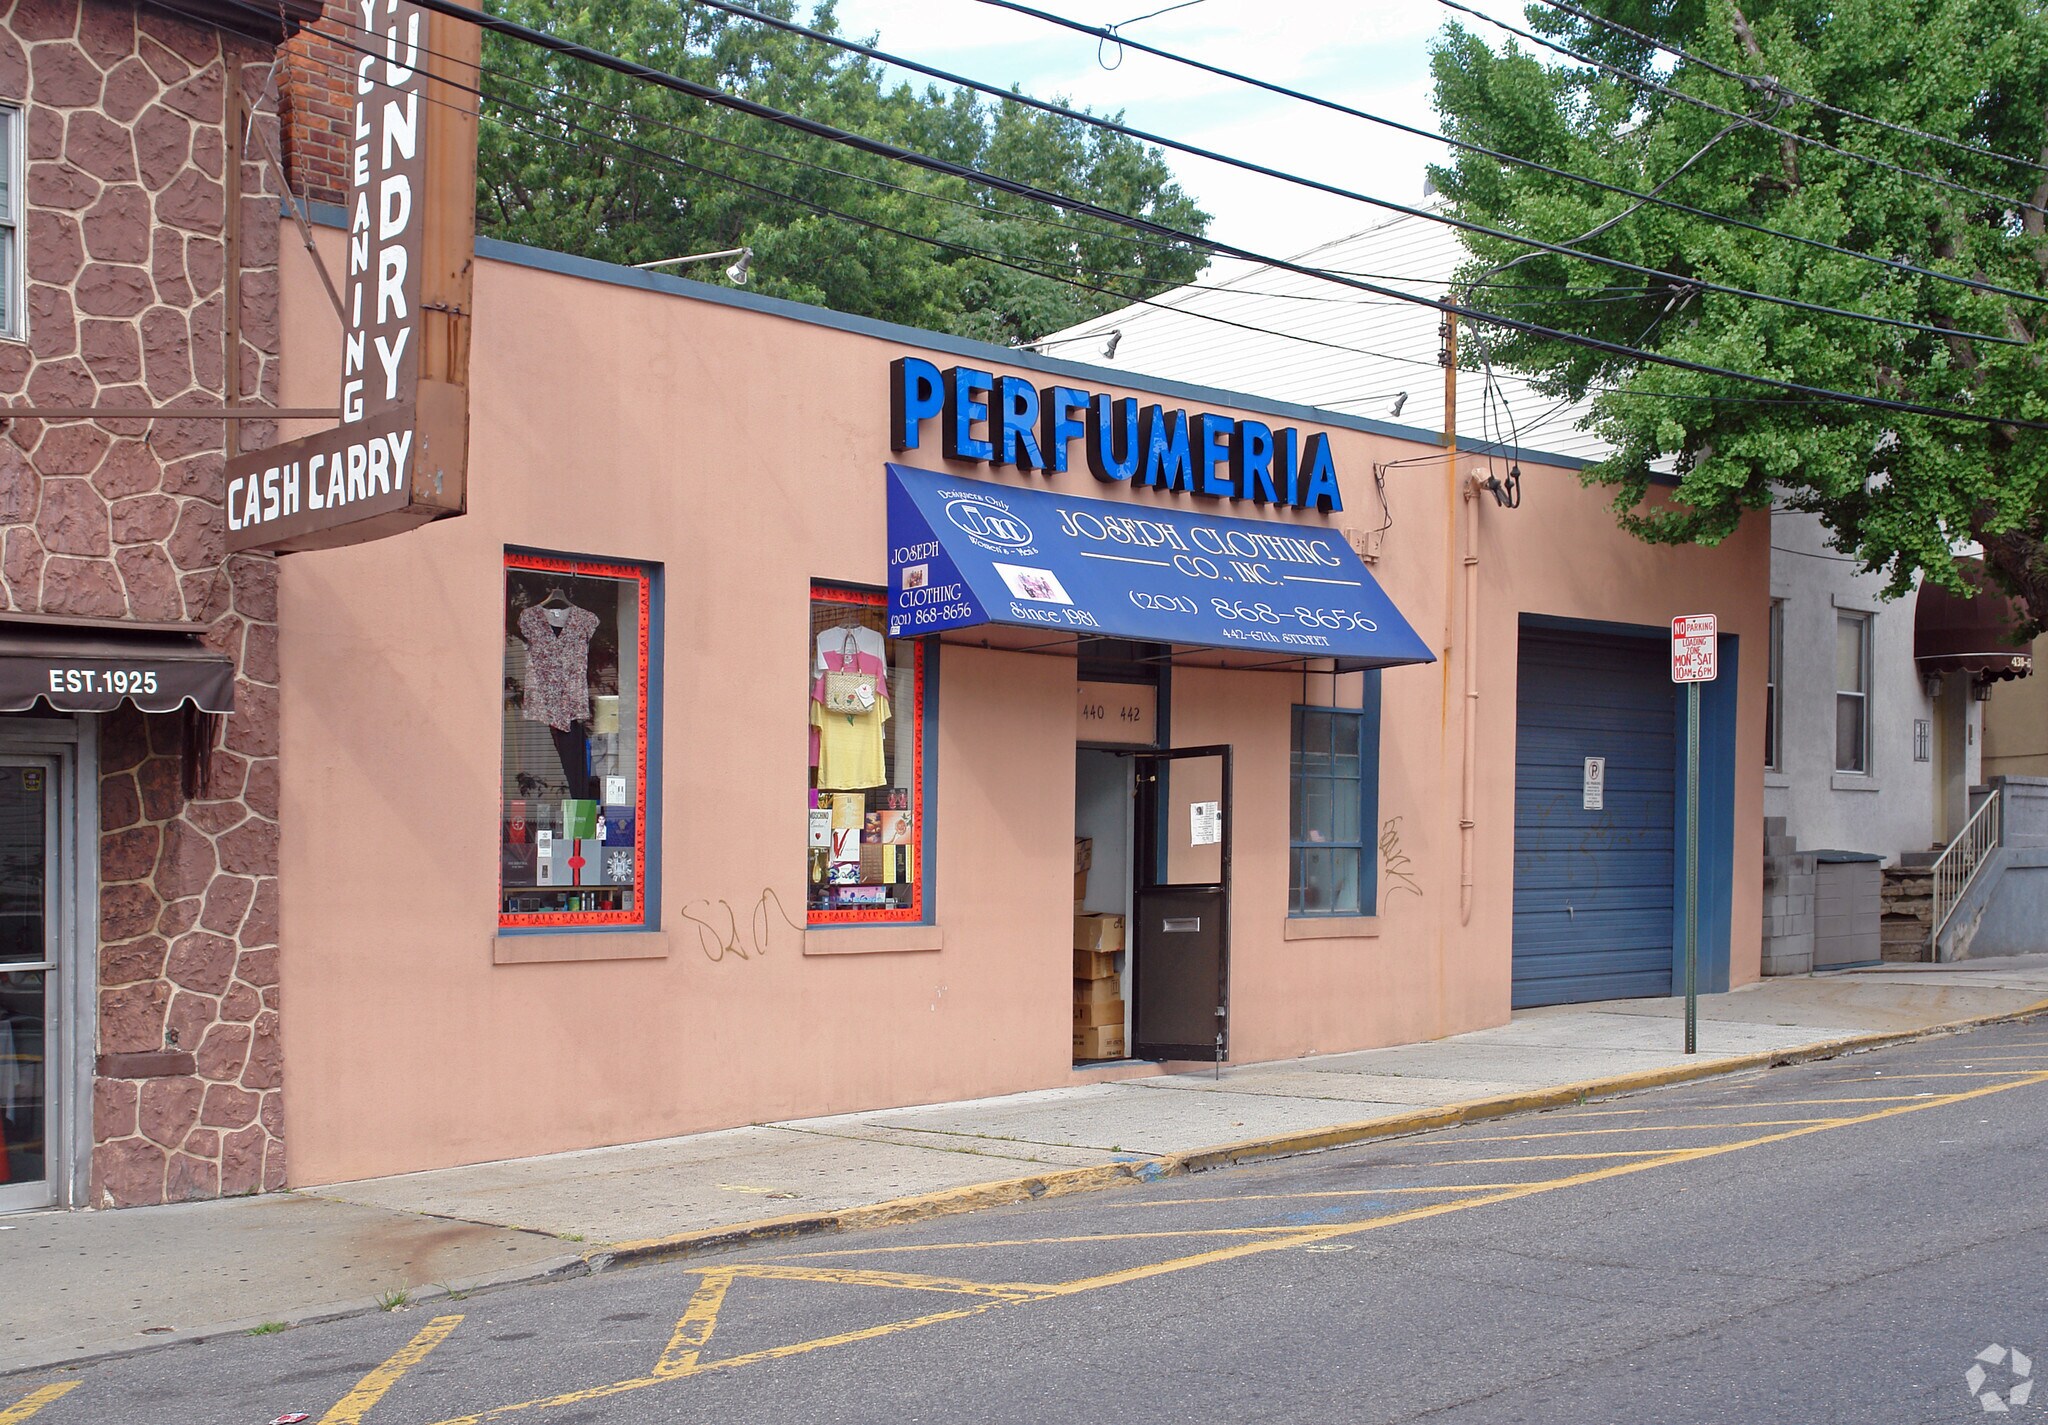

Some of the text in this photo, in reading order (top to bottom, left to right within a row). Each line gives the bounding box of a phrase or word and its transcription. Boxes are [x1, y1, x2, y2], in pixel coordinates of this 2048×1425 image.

[374, 0, 419, 400] UNDRY
[344, 55, 376, 423] CLEANING
[891, 357, 1343, 512] PERFUMERIA
[228, 430, 412, 531] CASH CARRY
[985, 495, 1010, 511] Only
[1056, 508, 1341, 567] JOSEPH CLOTHING
[891, 540, 940, 565] JOSEPH
[899, 583, 962, 609] CLOTHING
[891, 602, 972, 627] (201) 868-8656
[1009, 601, 1101, 627] Since 1981
[1128, 590, 1378, 633] (201) 868-8656
[1282, 633, 1331, 647] STREET
[1675, 622, 1713, 635] NO PARKING
[1682, 637, 1706, 647] LOADING
[1687, 646, 1700, 655] ZONE
[49, 670, 157, 694] EST.1925
[1083, 705, 1140, 722] 440 442
